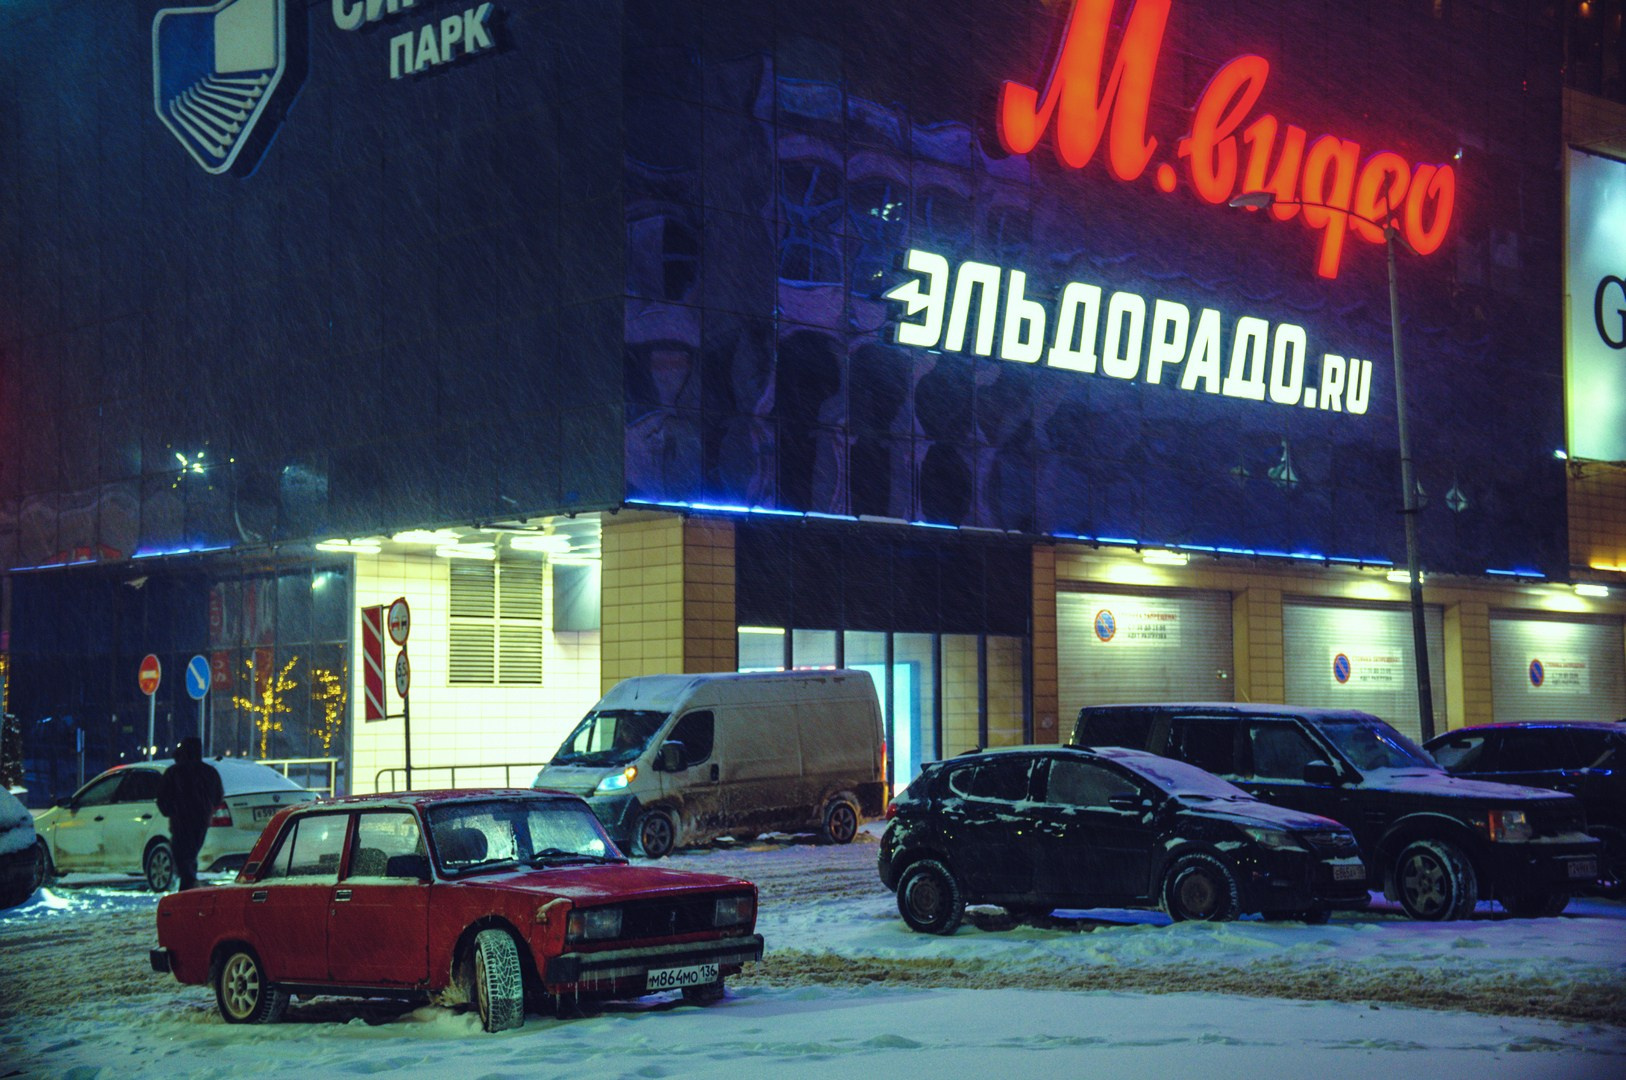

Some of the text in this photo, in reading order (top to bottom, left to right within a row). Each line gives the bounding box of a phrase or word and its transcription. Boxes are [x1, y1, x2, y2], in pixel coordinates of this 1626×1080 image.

[389, 2, 495, 80] ПАРК
[886, 249, 1374, 416] ЭЛЬДОРАДО.RU
[700, 964, 717, 977] 136
